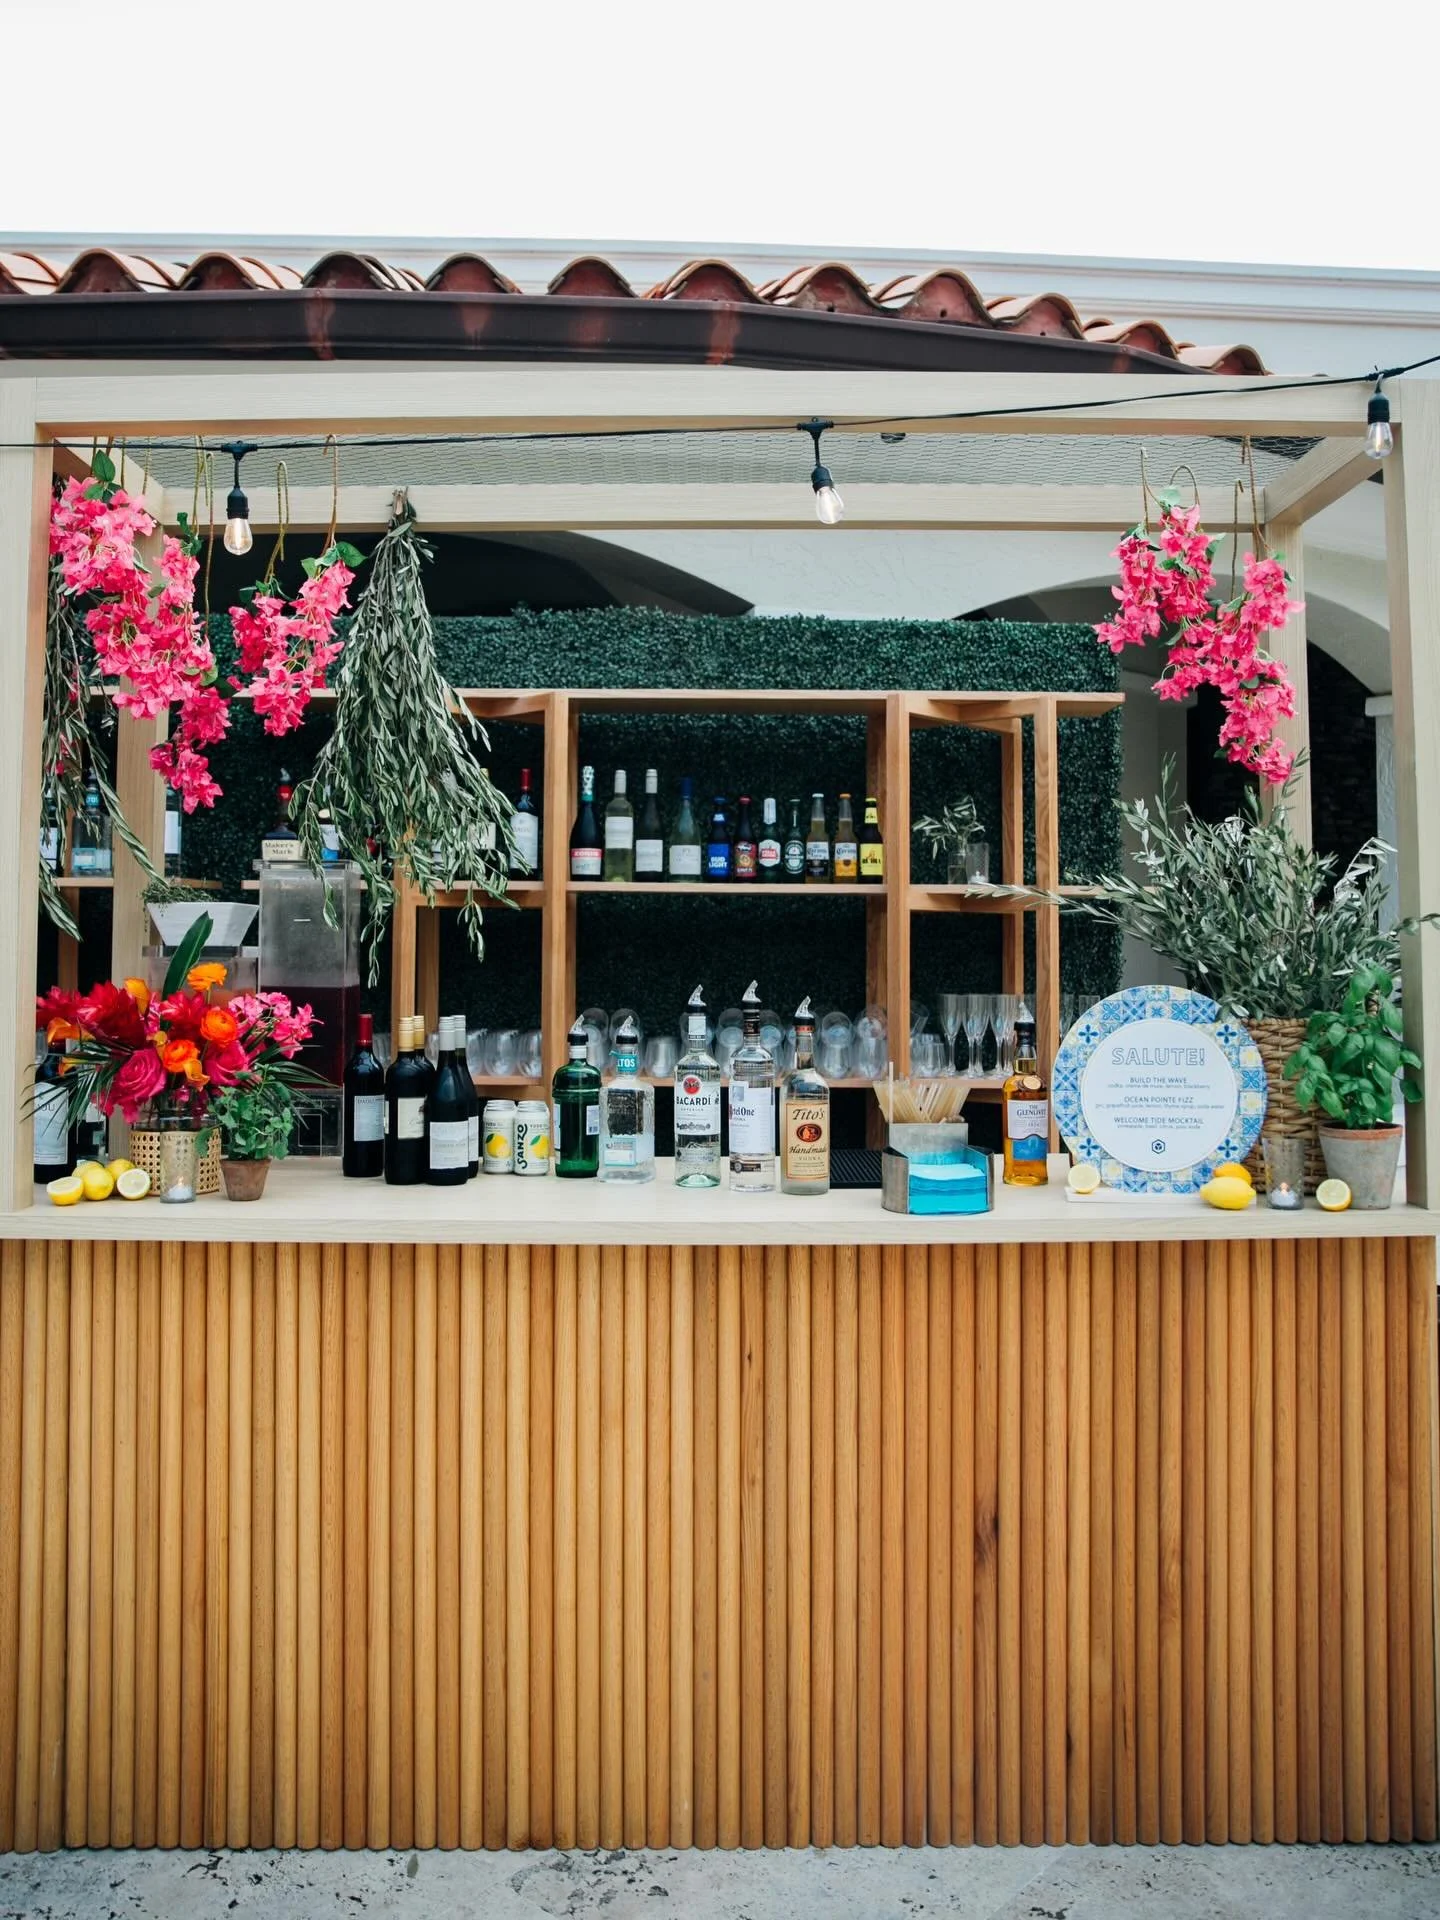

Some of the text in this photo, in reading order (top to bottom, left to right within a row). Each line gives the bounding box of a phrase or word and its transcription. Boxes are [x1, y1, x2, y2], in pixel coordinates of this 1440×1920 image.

[1111, 1047, 1206, 1066] SALUTE!
[792, 1107, 825, 1120] Tito's
[1168, 1117, 1204, 1125] MOCKTAIL
[517, 1123, 528, 1170] SANZO
